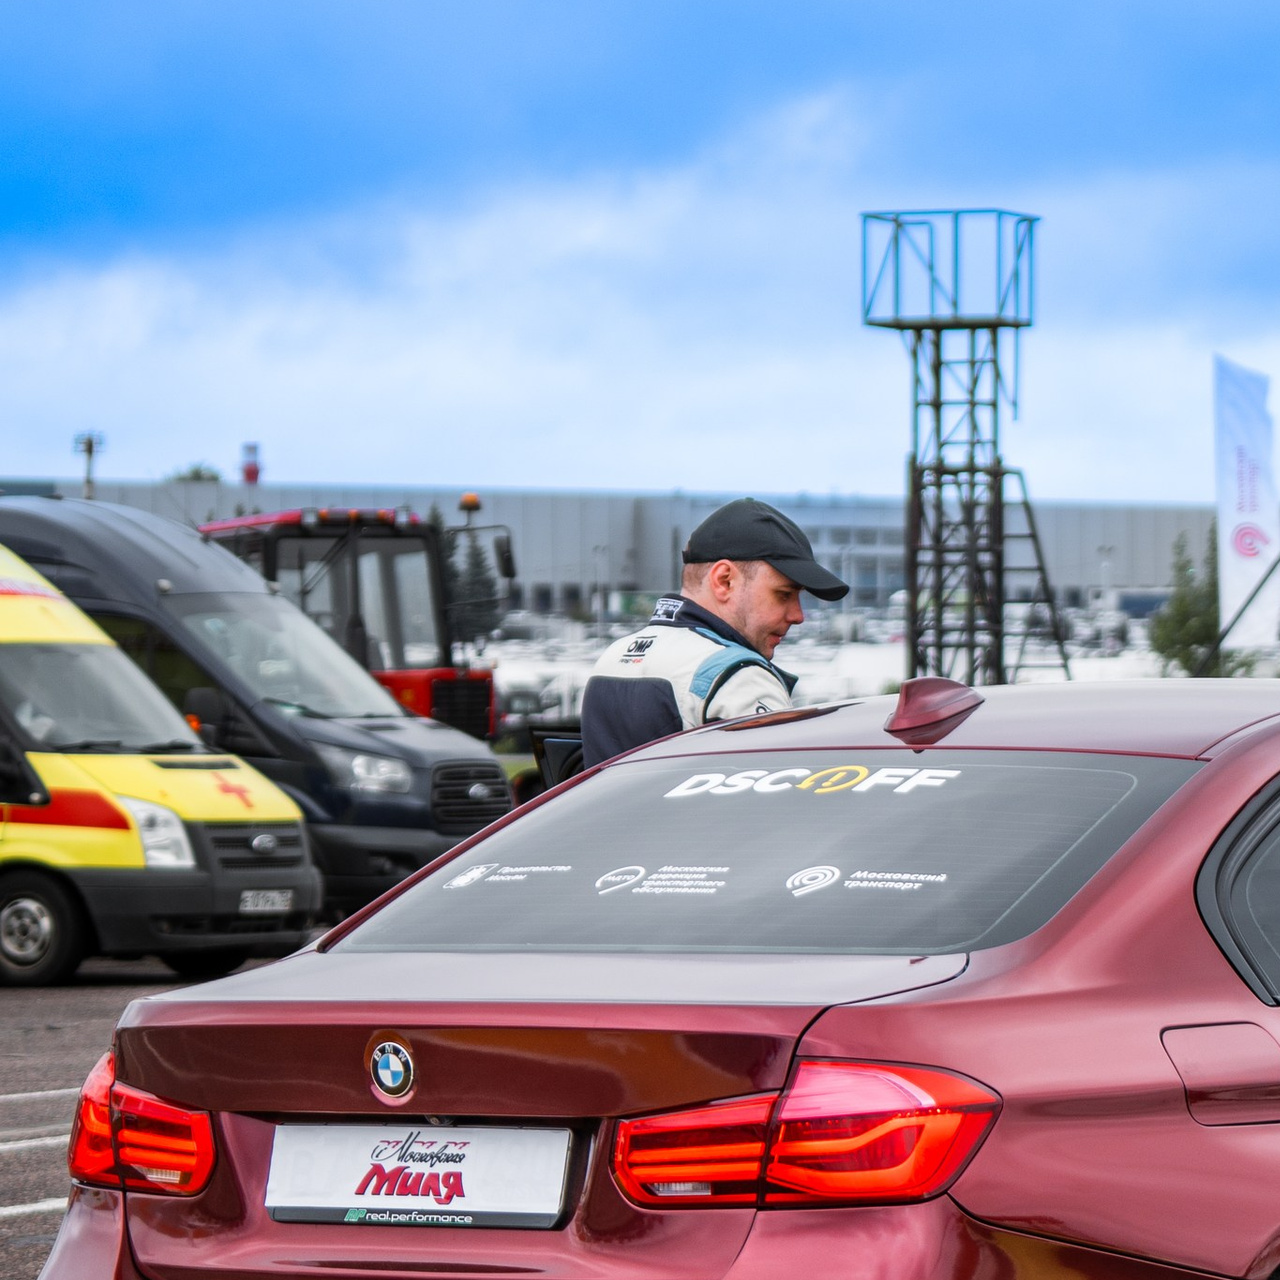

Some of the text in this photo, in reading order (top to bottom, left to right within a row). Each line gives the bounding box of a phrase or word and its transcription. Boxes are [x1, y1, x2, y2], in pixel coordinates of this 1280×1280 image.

[627, 639, 654, 653] OMP
[850, 870, 947, 882] Московский
[844, 880, 922, 890] транспорт
[373, 1044, 408, 1062] BMW
[371, 1131, 466, 1167] Московская
[354, 1163, 466, 1205] Миля
[366, 1210, 473, 1224] real.performance
